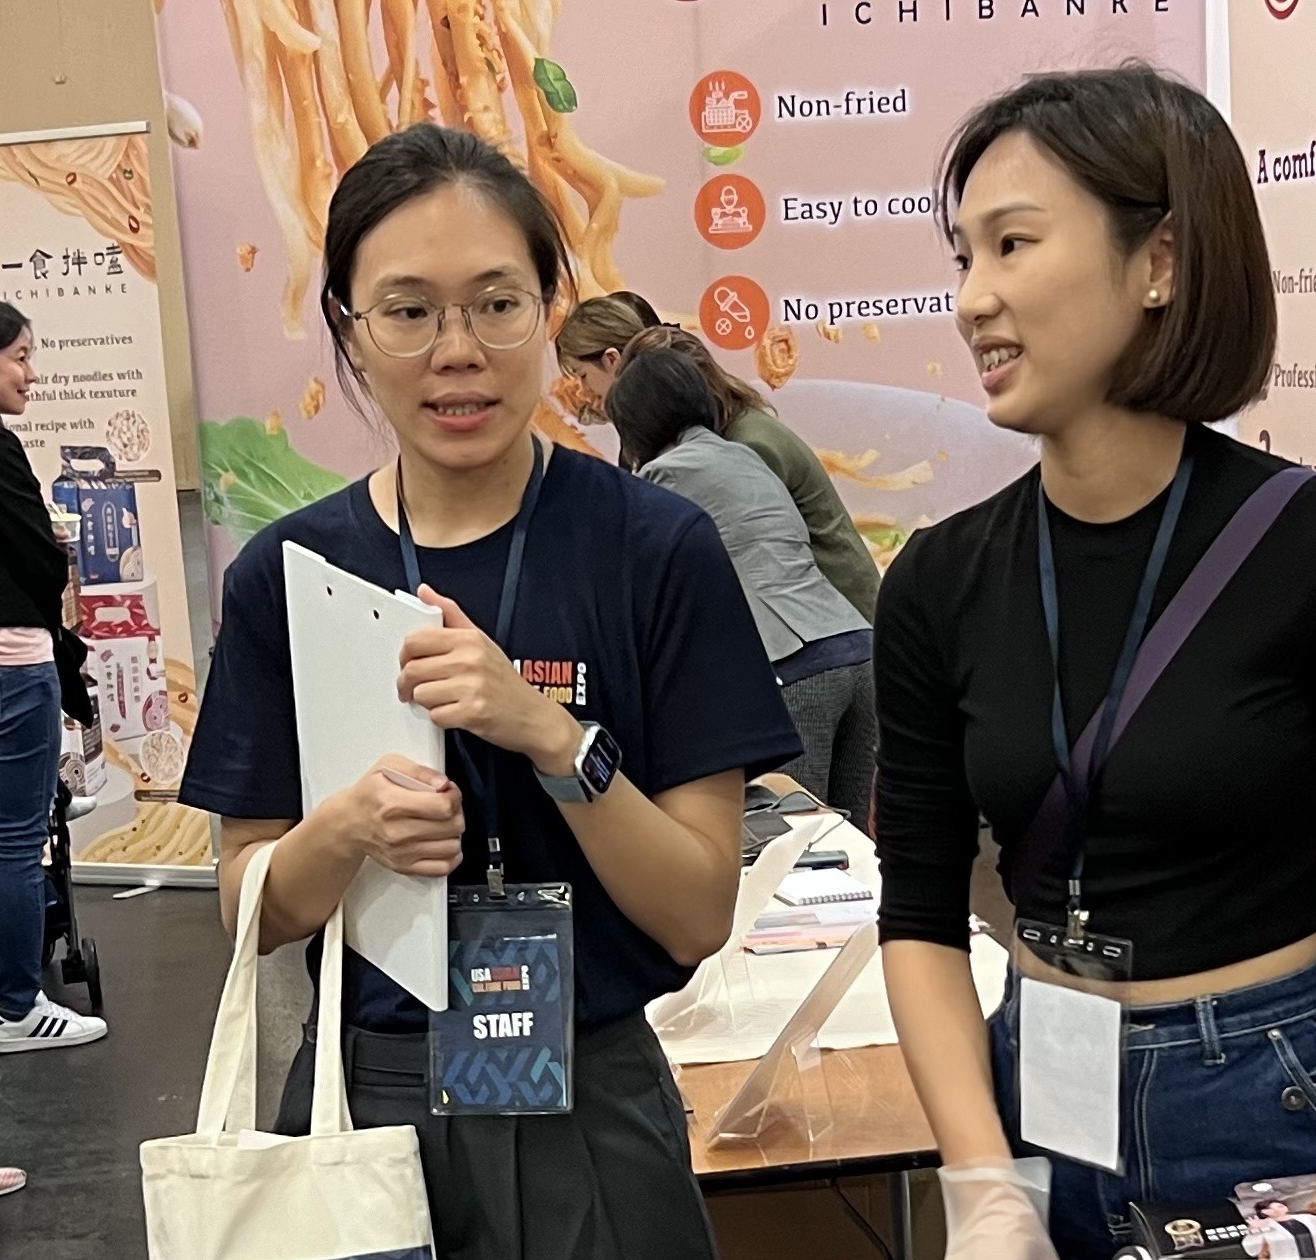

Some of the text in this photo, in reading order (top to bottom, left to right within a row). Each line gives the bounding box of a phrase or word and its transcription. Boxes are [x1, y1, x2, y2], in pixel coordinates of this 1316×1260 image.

[777, 89, 907, 119] Non-fried
[1256, 149, 1269, 184] A
[783, 197, 842, 224] Easy
[853, 196, 878, 217] to
[3, 283, 127, 300] ICHIBANKE
[783, 291, 955, 324] No preservat
[41, 335, 133, 350] No preservatives
[52, 373, 69, 386] dry
[73, 370, 113, 383] noodles
[117, 369, 143, 380] with
[59, 388, 87, 400] thick
[89, 388, 137, 399] texuture
[35, 420, 67, 433] recipe
[70, 419, 95, 430] with
[523, 660, 573, 685] ASIAN
[473, 1011, 534, 1039] STAFF
